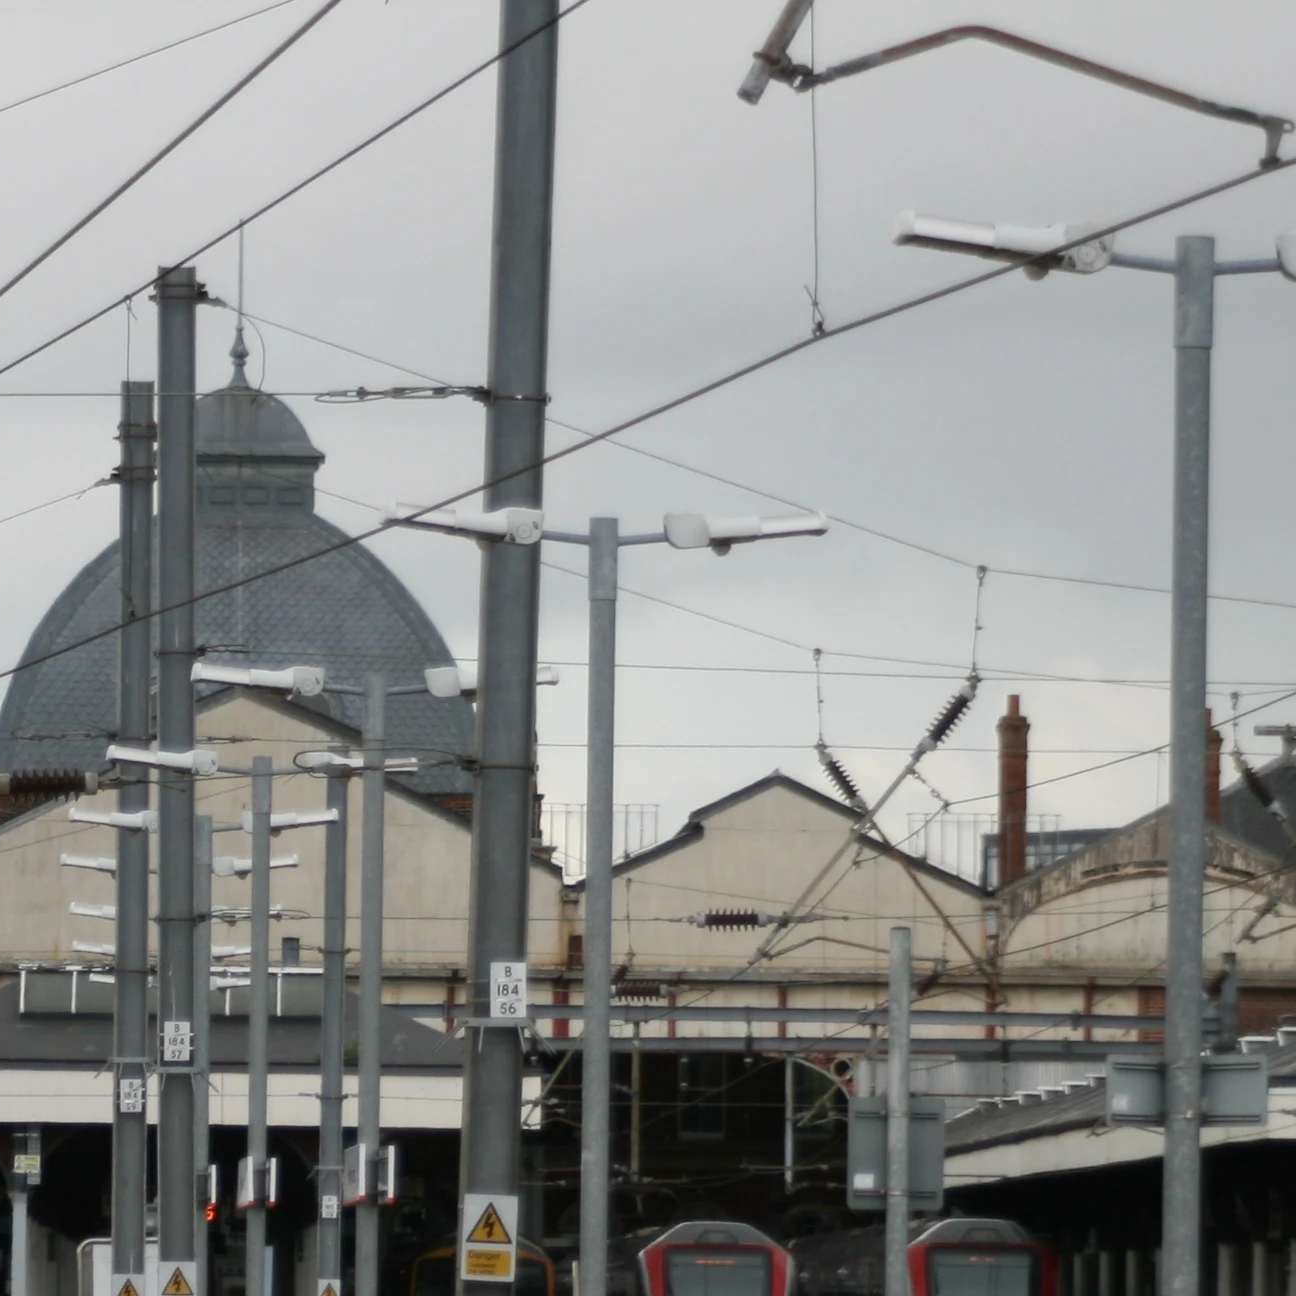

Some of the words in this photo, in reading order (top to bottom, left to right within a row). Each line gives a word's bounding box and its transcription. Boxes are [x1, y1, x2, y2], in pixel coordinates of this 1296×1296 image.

[497, 984, 519, 996] 184
[500, 1003, 517, 1015] 56
[169, 1037, 185, 1046] 184
[171, 1050, 183, 1059] 57
